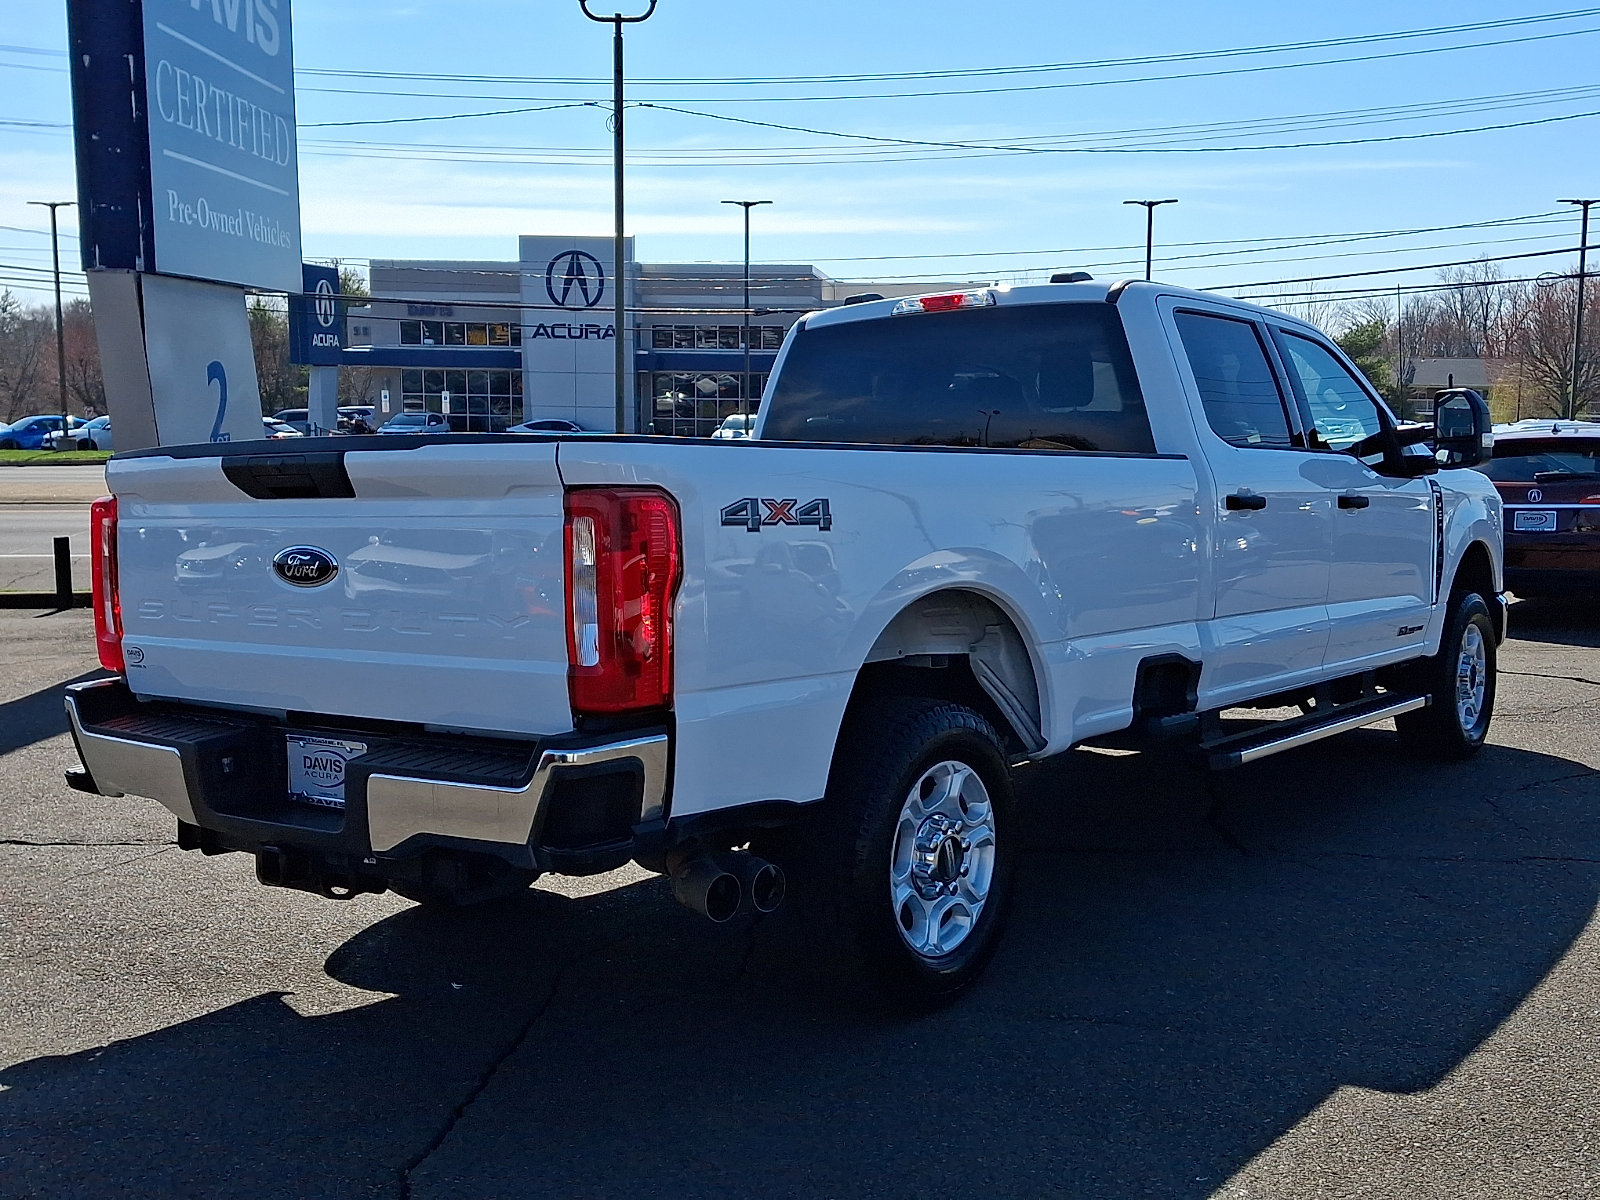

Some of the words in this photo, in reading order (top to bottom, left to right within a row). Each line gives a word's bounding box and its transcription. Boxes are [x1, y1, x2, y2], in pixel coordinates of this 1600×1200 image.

[156, 59, 290, 167] CERTIFIED
[167, 189, 243, 237] Pre-Owned
[245, 209, 291, 249] Vehicles
[312, 333, 340, 347] ACURA
[531, 323, 616, 339] ACURA
[206, 360, 228, 442] 2
[284, 554, 320, 577] Ford
[138, 599, 323, 630] SUPER
[341, 607, 532, 639] DUTY
[303, 756, 343, 773] DAVIS
[304, 770, 340, 780] ACURA
